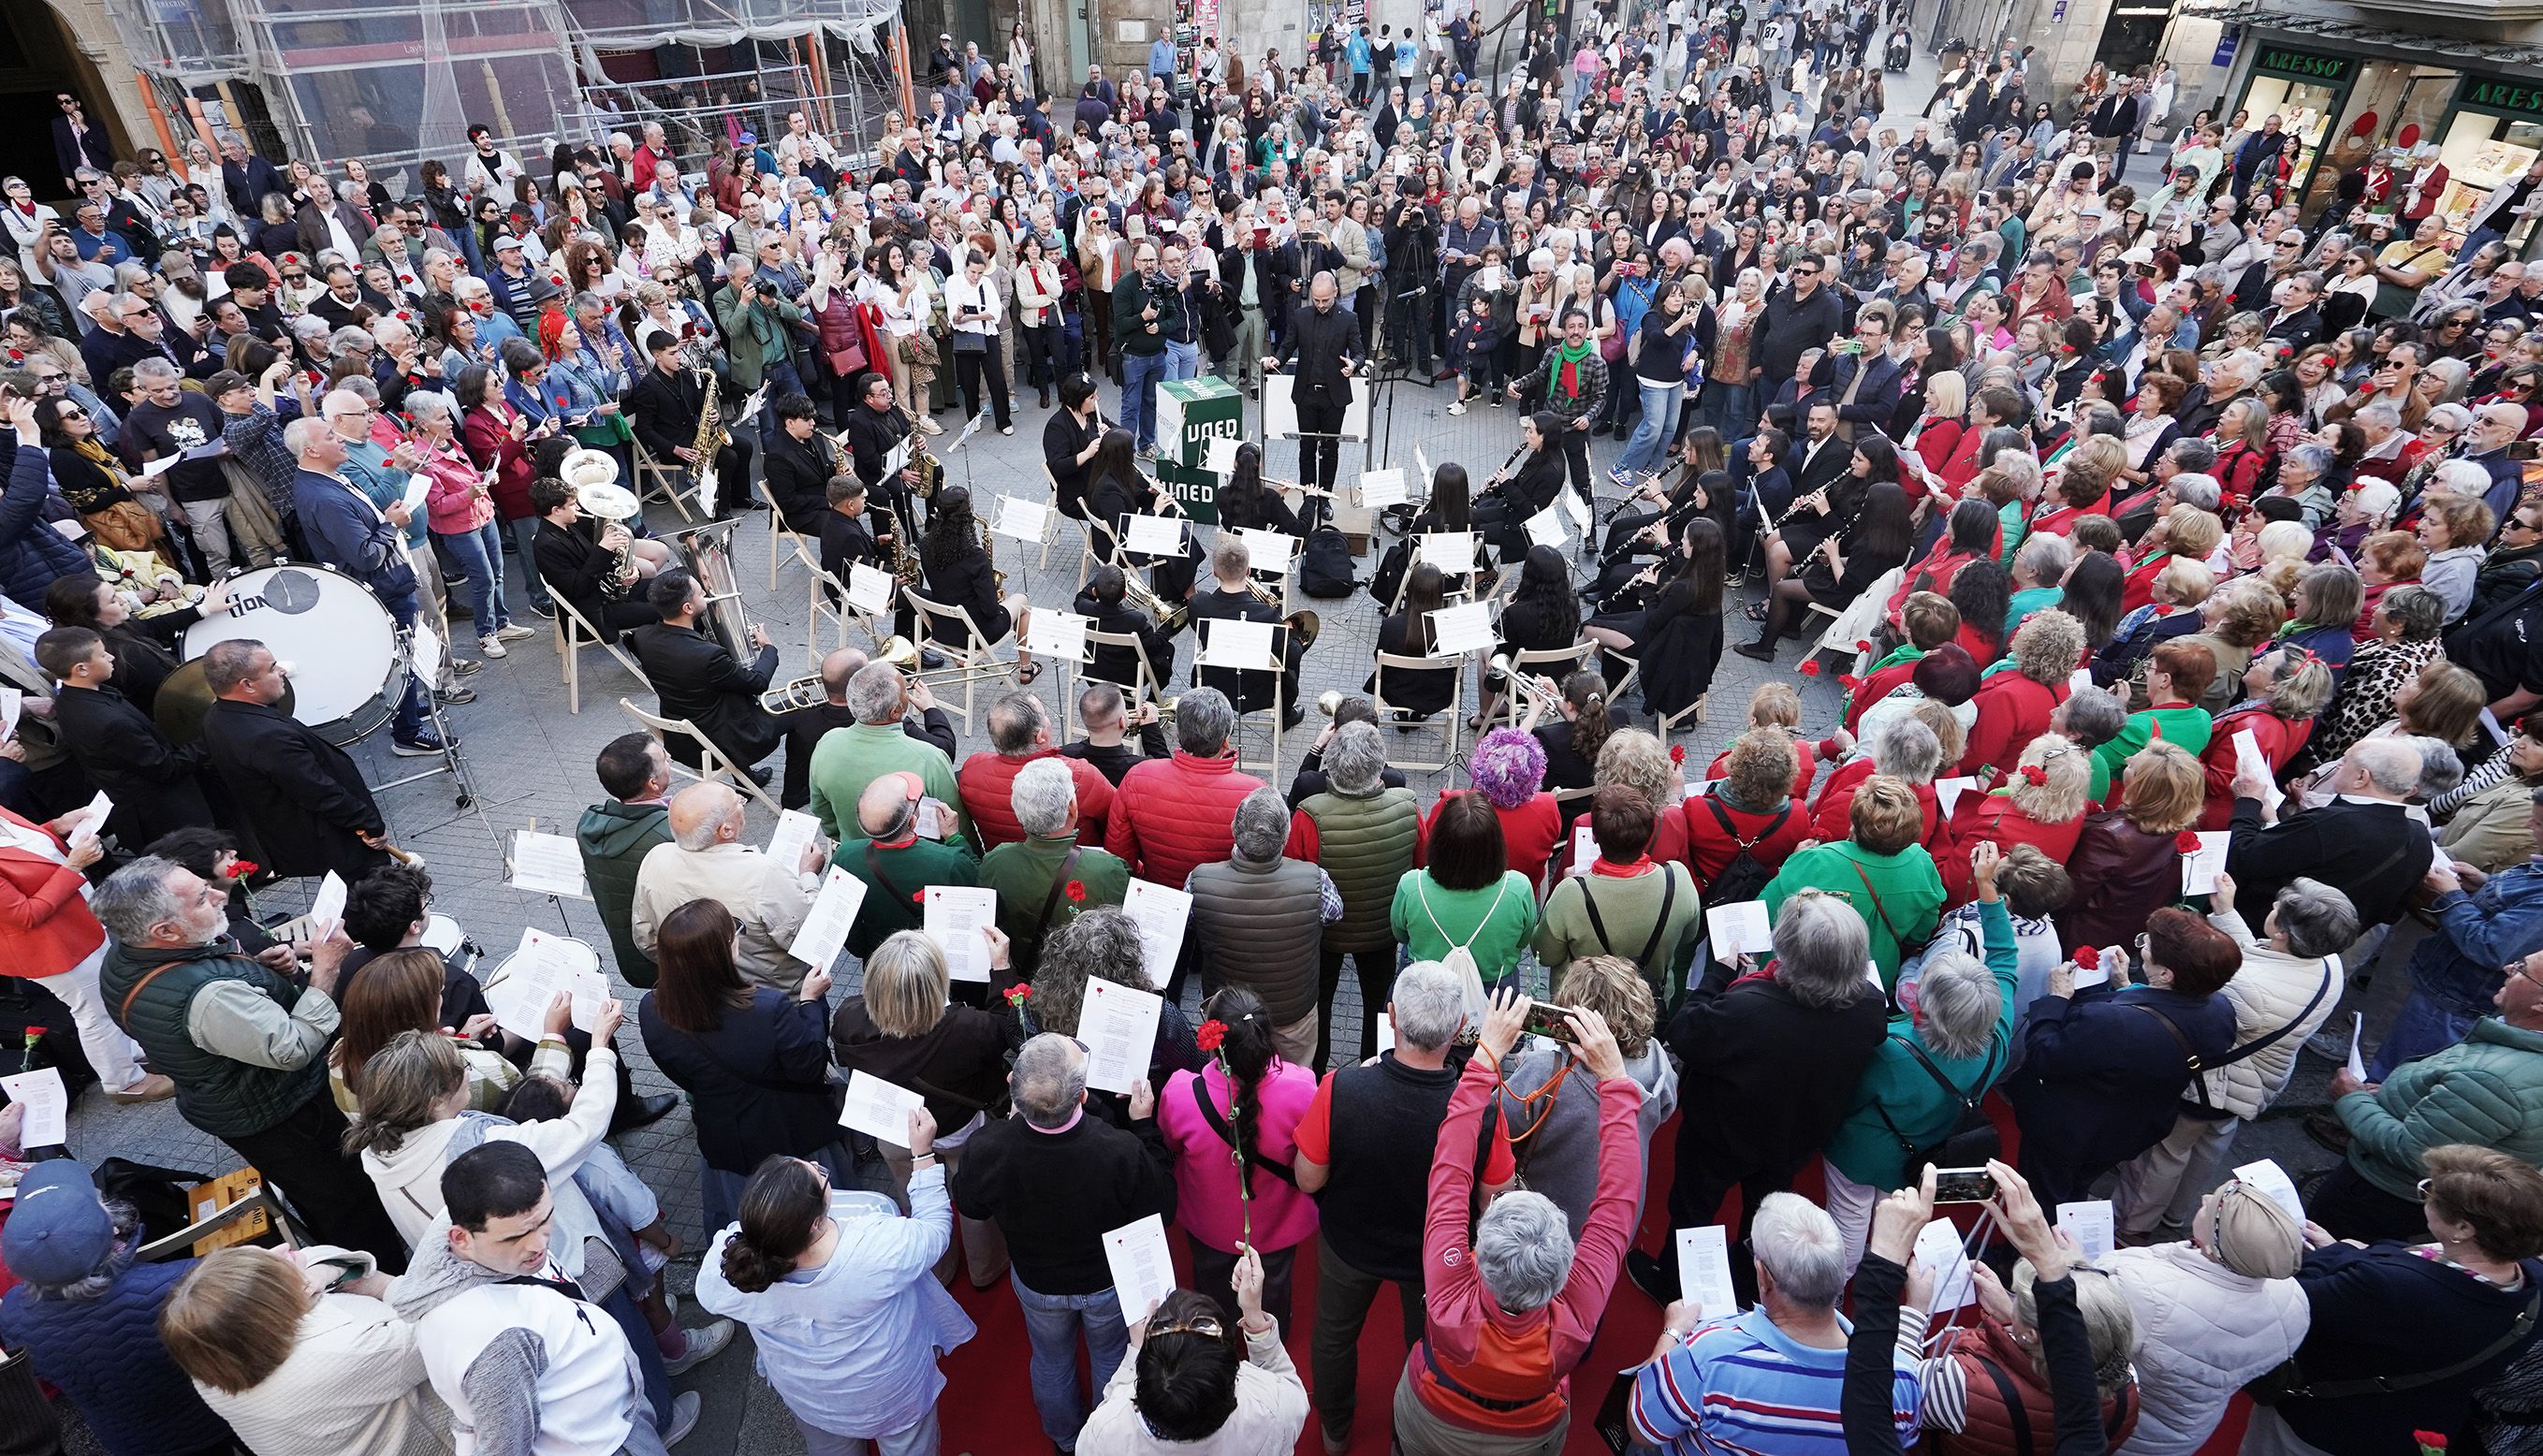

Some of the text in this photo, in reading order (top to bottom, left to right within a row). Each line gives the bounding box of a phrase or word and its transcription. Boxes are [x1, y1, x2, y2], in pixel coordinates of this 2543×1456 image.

[1764, 26, 1777, 39] 87
[403, 43, 431, 54] Layhr
[2263, 51, 2339, 77] ARESSO
[2470, 83, 2543, 110] ARES
[1188, 418, 1237, 443] UNED
[1162, 481, 1214, 502] UNED
